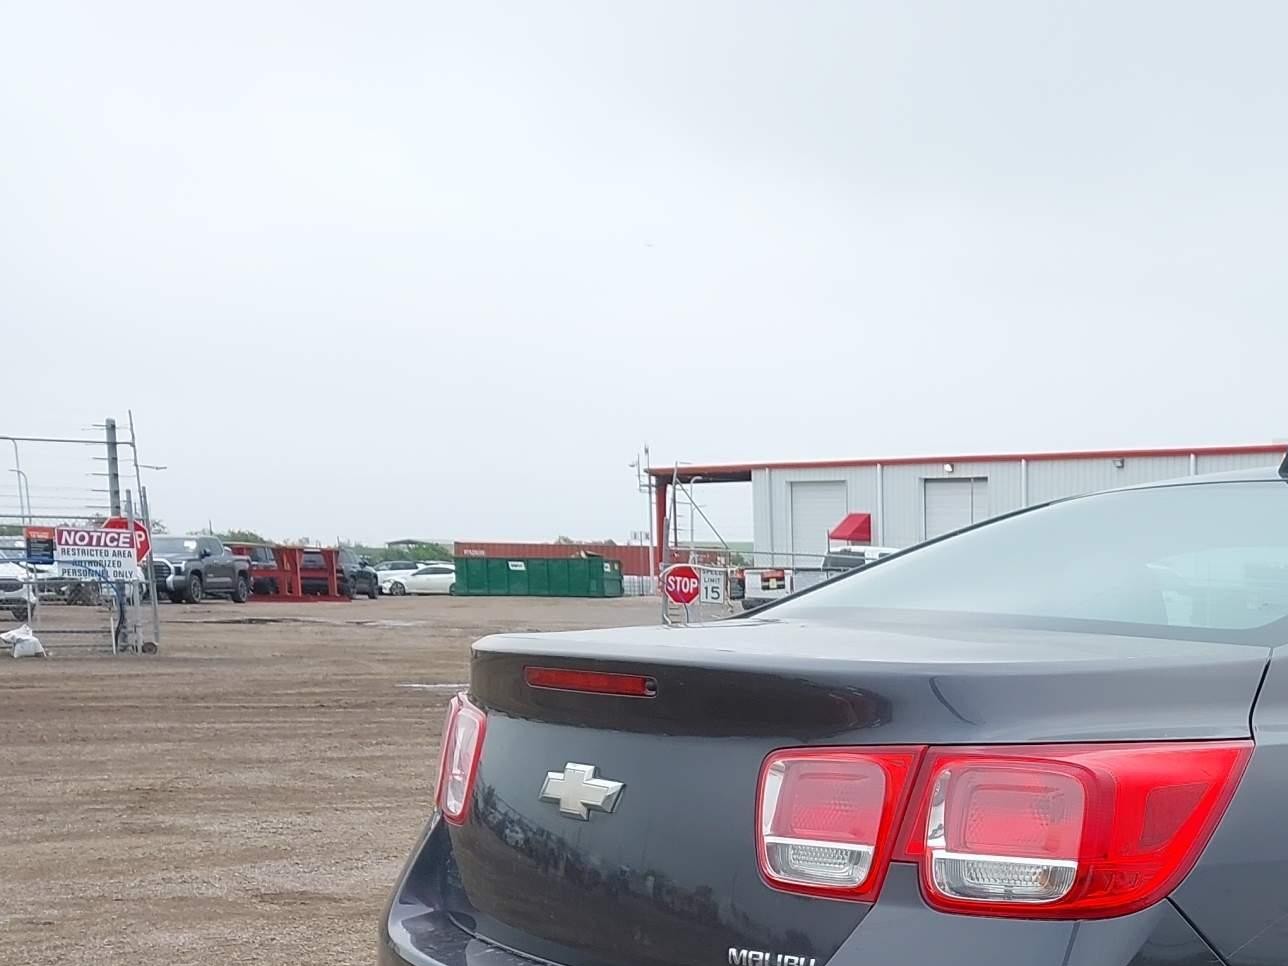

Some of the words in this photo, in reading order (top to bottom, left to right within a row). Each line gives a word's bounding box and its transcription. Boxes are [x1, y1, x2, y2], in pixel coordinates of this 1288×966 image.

[61, 530, 131, 547] NOTICE
[61, 547, 109, 558] RESTRICTED
[112, 550, 133, 558] AREA
[61, 568, 111, 578] PERSONNEL
[113, 570, 134, 579] ONLY
[667, 576, 698, 594] STOP
[704, 586, 720, 600] 15
